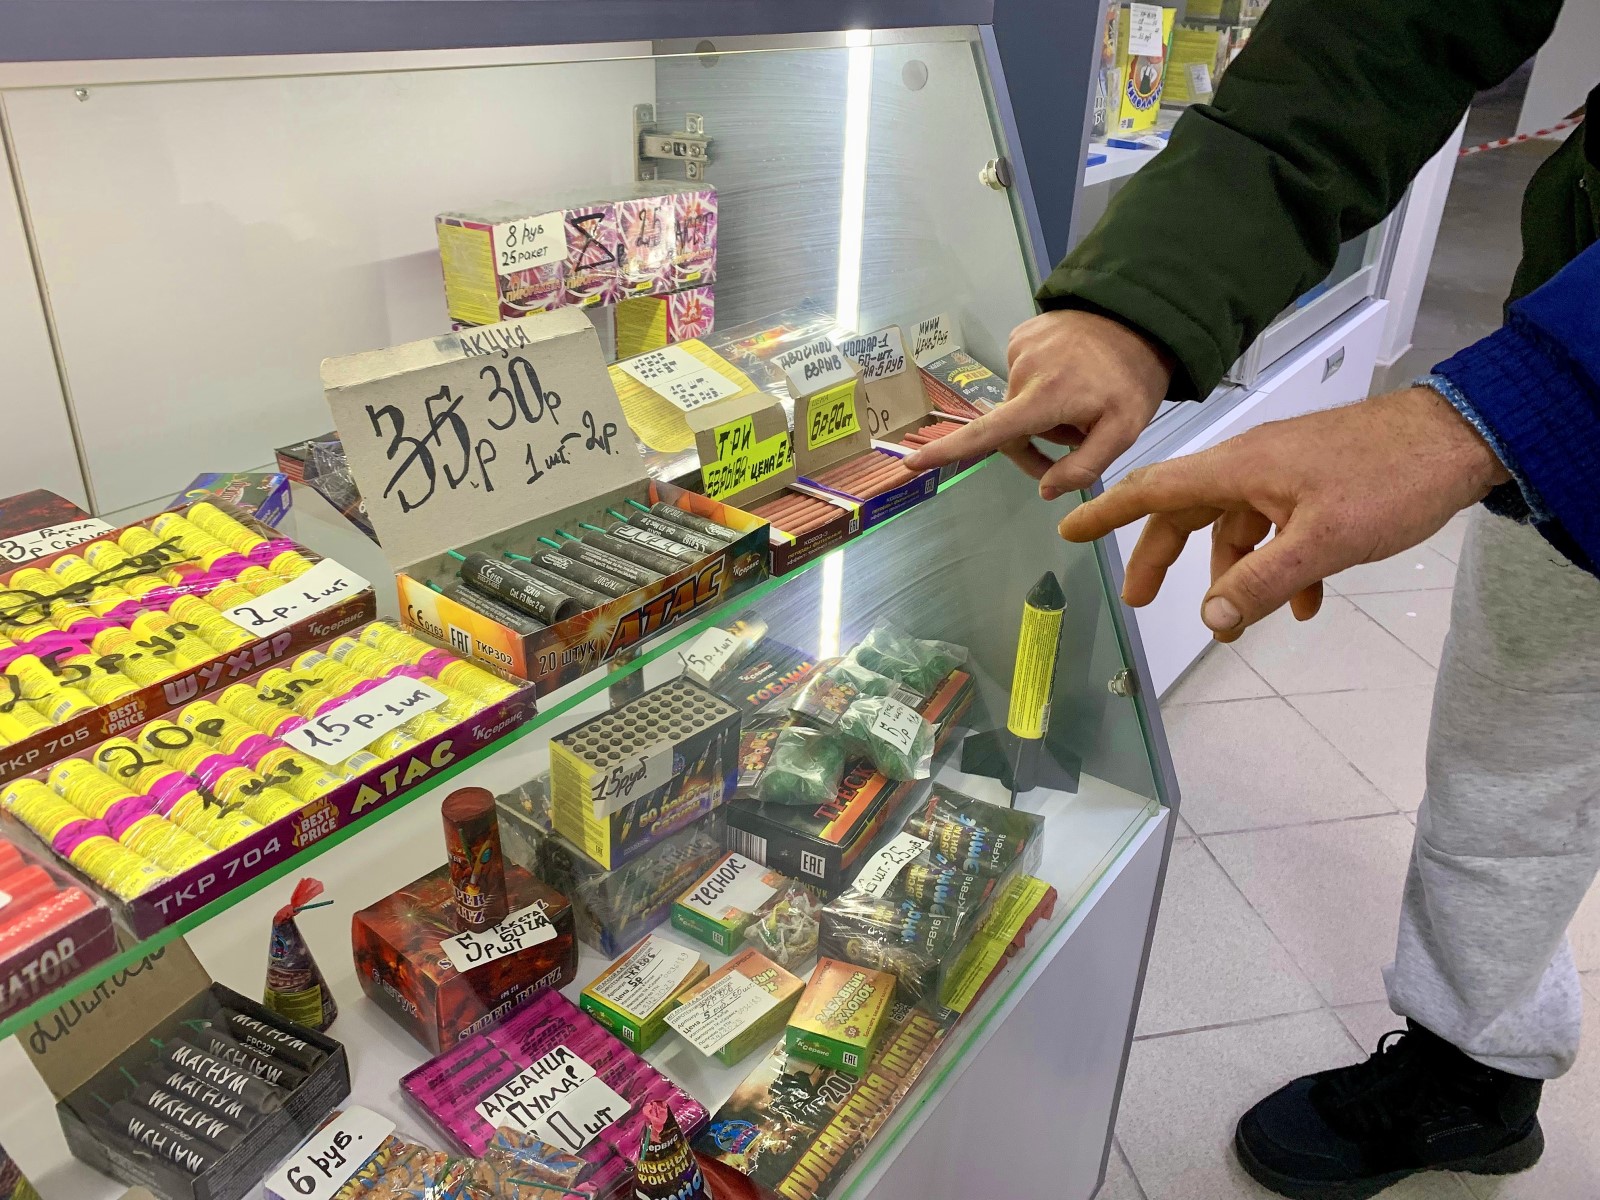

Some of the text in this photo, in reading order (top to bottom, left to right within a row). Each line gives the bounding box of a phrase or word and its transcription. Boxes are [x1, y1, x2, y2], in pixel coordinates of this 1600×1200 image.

[505, 223, 545, 248] 8 руб
[460, 324, 532, 359] АКЦИЯ
[780, 337, 832, 370] ДВОЙНОЙ
[804, 354, 842, 380] ВЗРЫВ
[480, 356, 561, 431] 30р
[601, 553, 726, 665] АТАС
[424, 622, 445, 638] 0163
[162, 632, 293, 706] ШУХЕР
[538, 653, 557, 677] 20
[108, 700, 139, 722] BEST
[108, 711, 146, 735] PRICE
[43, 726, 91, 754] 705
[350, 739, 457, 816] АТАС
[299, 819, 338, 848] PRICE
[301, 808, 332, 833] BEST
[221, 836, 283, 879] 704
[803, 853, 823, 876] EAC
[990, 833, 1007, 870] TKF816
[458, 1000, 512, 1042] SUPER
[515, 966, 562, 1006] BLITZ
[613, 989, 630, 1002] Цена
[815, 971, 868, 1025] ЗАБАВНЫЙ
[835, 984, 877, 1025] ХЛОПОК
[232, 1014, 309, 1051] МАГНУМ
[622, 1025, 634, 1041] EAC
[682, 1020, 701, 1034] Цена
[208, 1038, 284, 1085] МАГНУМ
[843, 1053, 858, 1066] EAC
[880, 1014, 942, 1078] ЛЕНТА
[171, 1045, 250, 1095] МАГНУМ
[165, 1071, 246, 1119] МАГНУМ
[148, 1089, 230, 1140] МАГНУМ
[127, 1117, 204, 1174] МАГНУМ
[287, 1166, 316, 1195] 6
[637, 1158, 690, 1185] ФОНТАН
